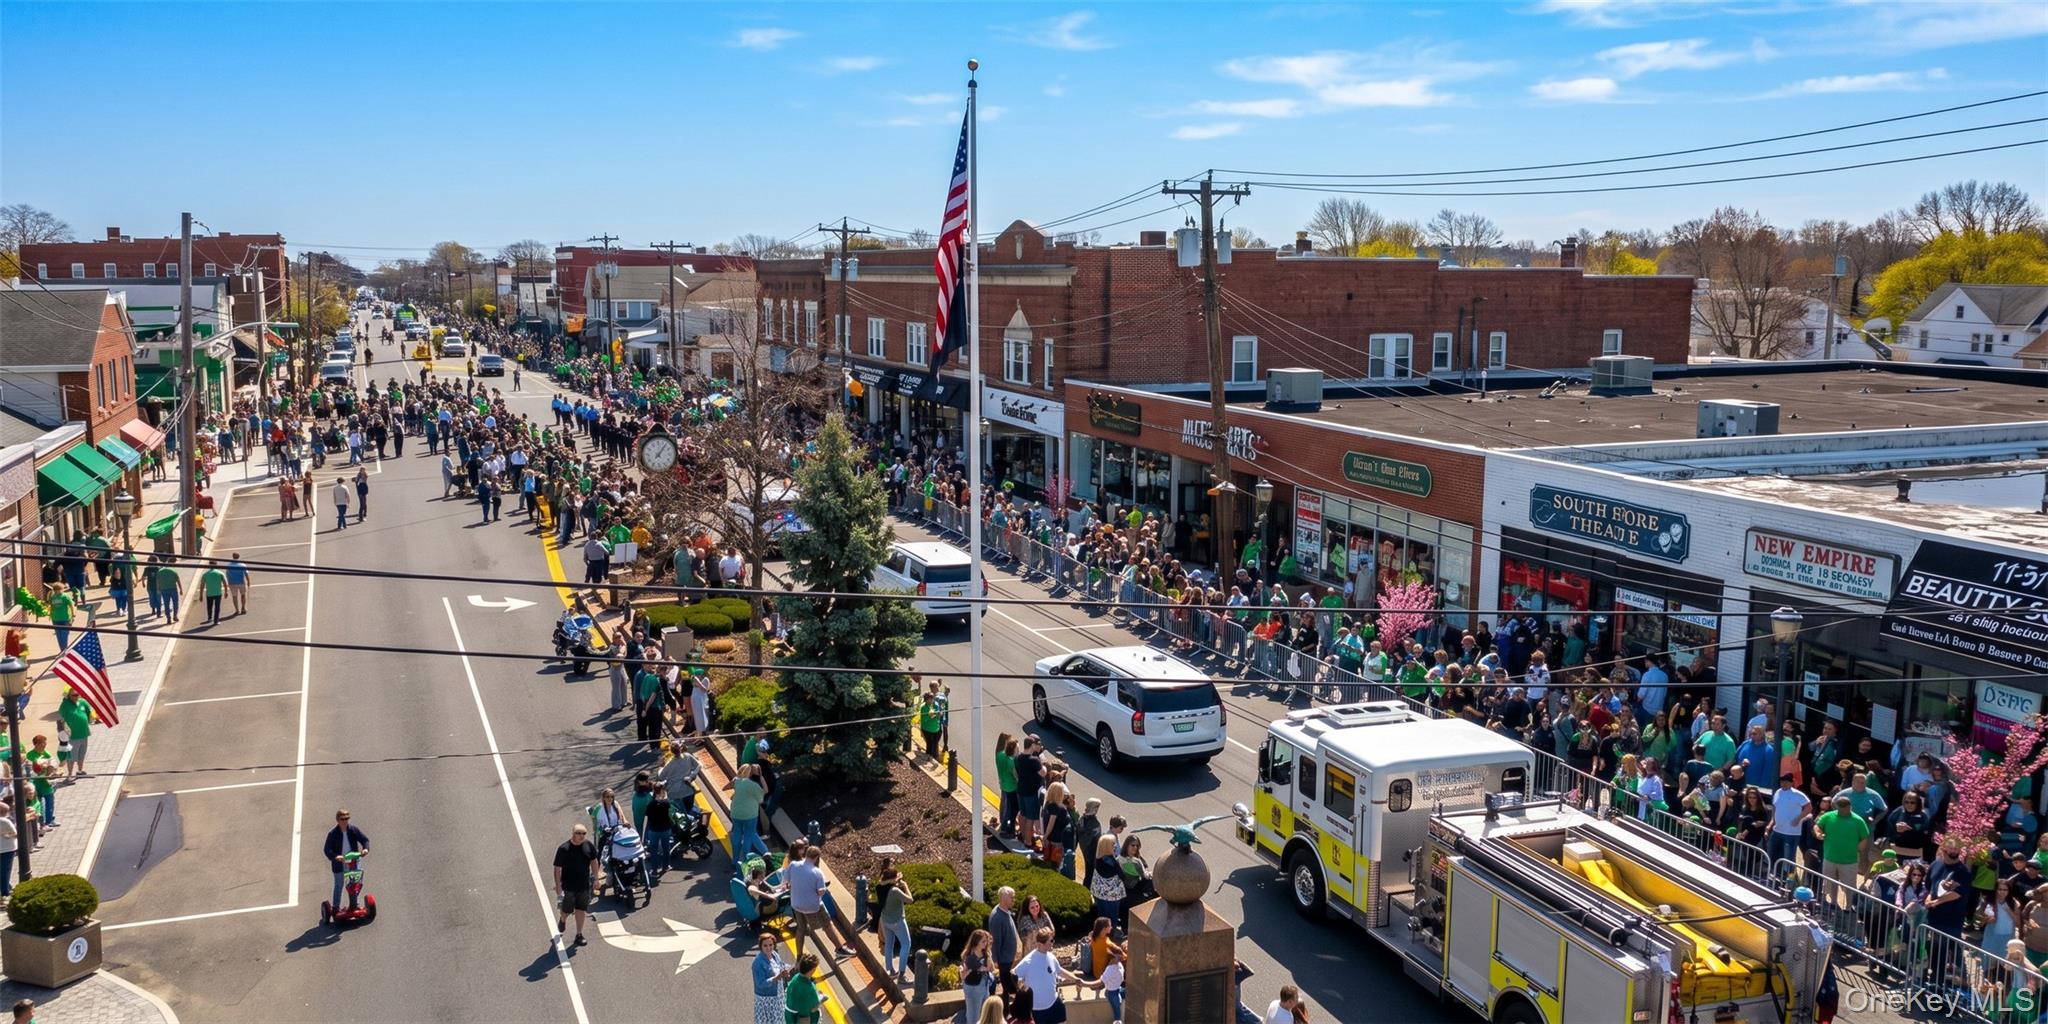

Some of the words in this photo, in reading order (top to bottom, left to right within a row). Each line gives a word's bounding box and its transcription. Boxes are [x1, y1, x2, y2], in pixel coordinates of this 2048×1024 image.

[1553, 494, 1607, 519] SOUTH
[1754, 534, 1796, 558] NEW
[1802, 544, 1876, 576] EMPIRE
[1906, 575, 2023, 614] BEAUTTY
